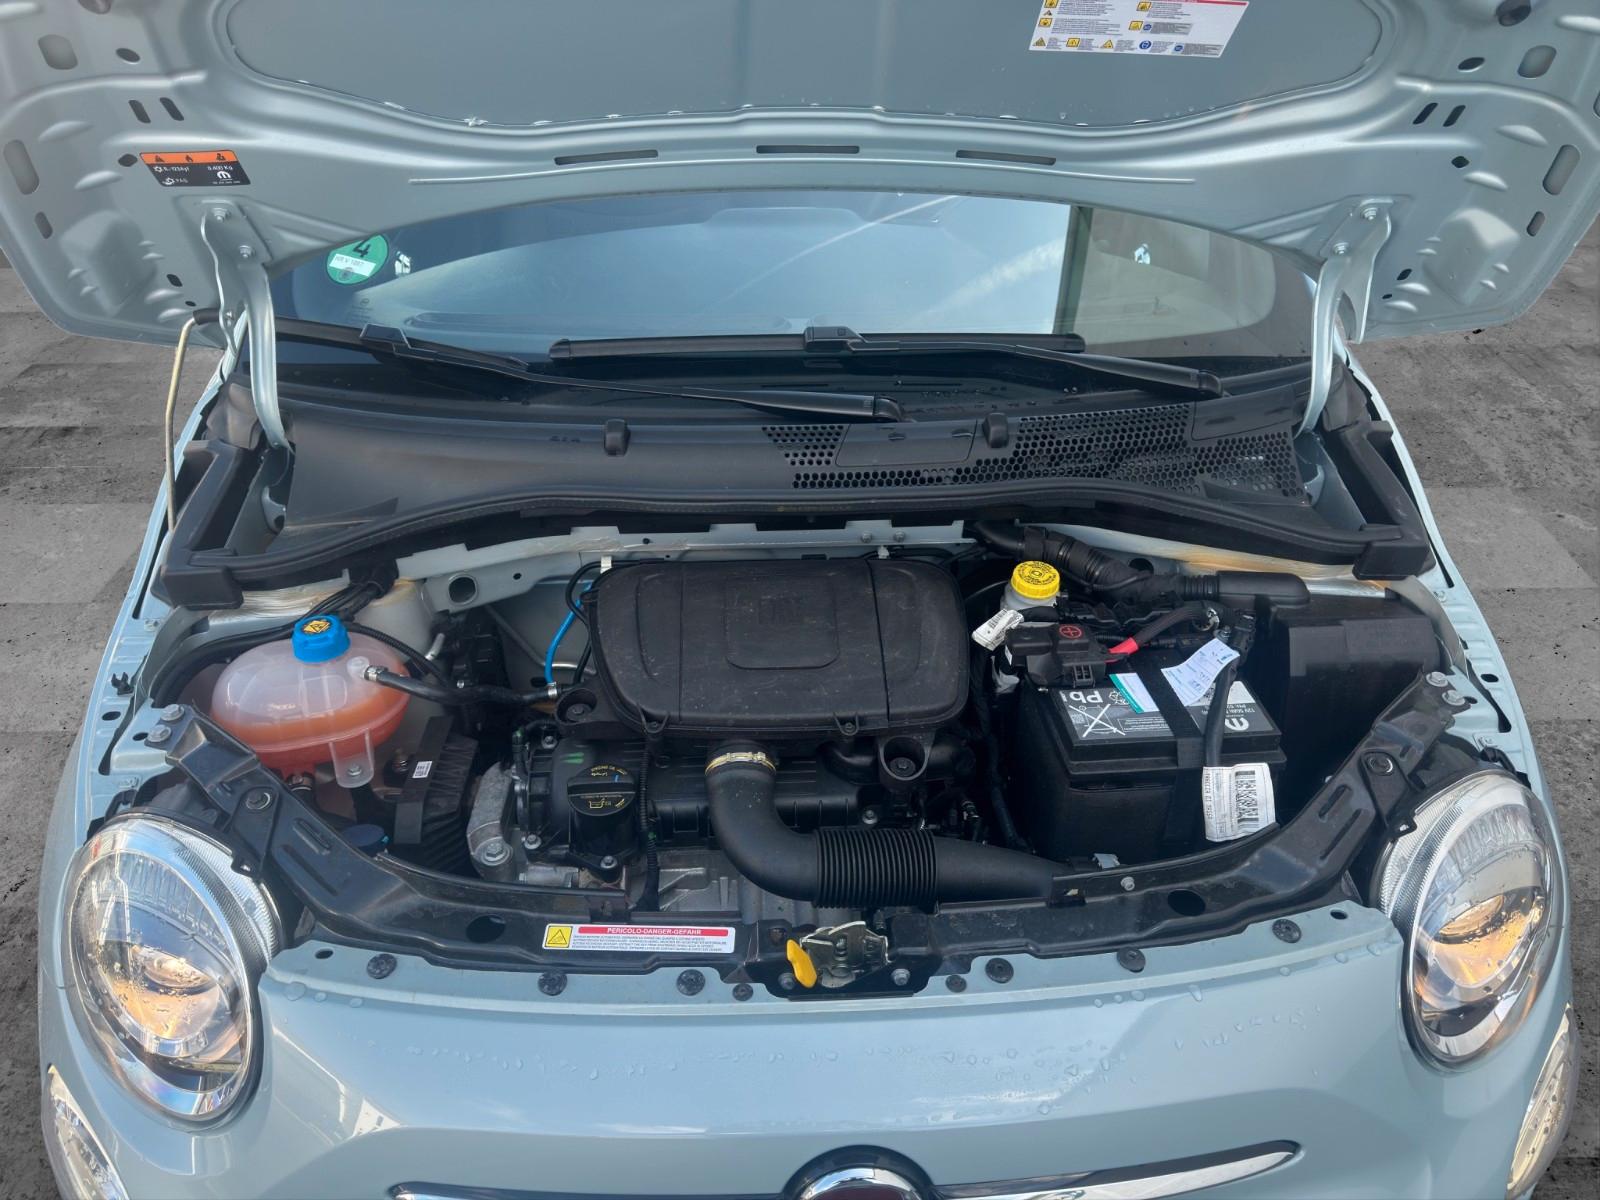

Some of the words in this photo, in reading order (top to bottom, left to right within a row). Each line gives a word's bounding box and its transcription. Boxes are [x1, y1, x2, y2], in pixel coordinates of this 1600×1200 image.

[353, 240, 371, 257] 4
[1068, 690, 1104, 703] Pb
[607, 927, 702, 935] PERICOLO-DANGER-GEFAHR
